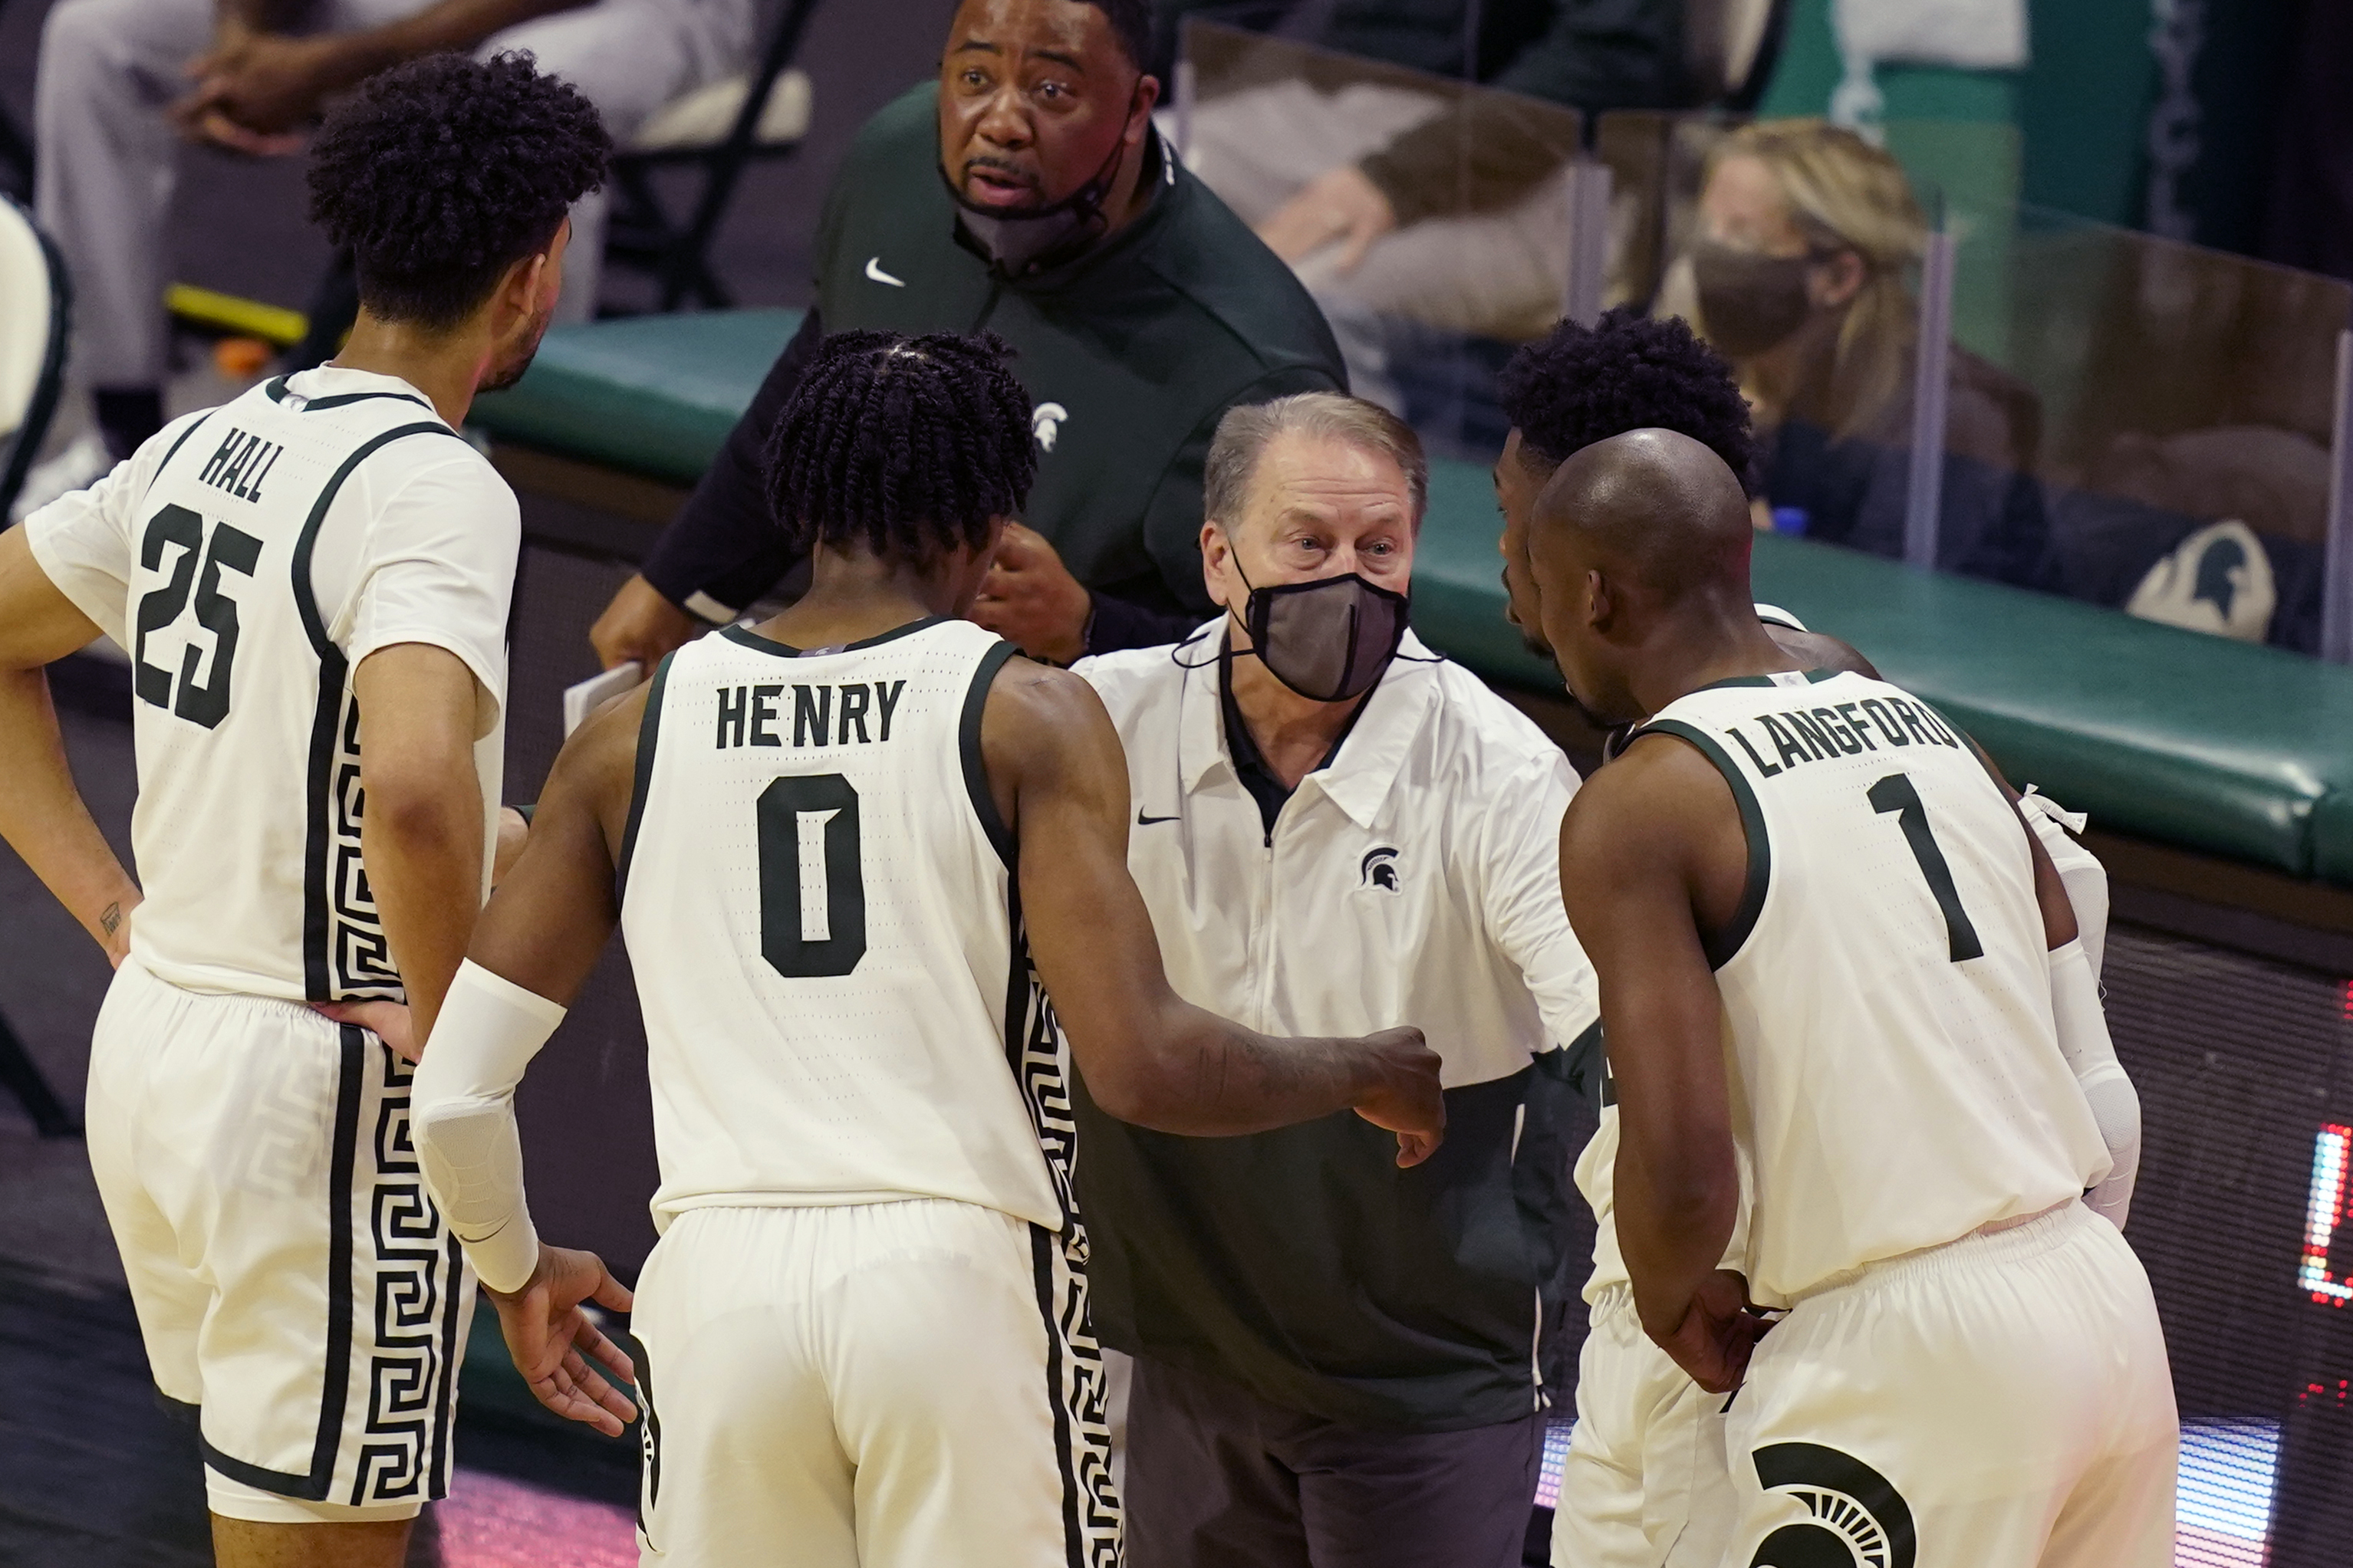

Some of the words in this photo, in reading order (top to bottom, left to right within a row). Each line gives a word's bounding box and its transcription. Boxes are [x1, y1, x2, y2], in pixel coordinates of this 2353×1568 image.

[199, 427, 285, 504] HALL
[135, 502, 265, 731] 25
[716, 679, 907, 750] HENRY
[1725, 696, 1959, 779] LANGFORD
[756, 772, 867, 978] 0
[1866, 772, 1985, 963] 1
